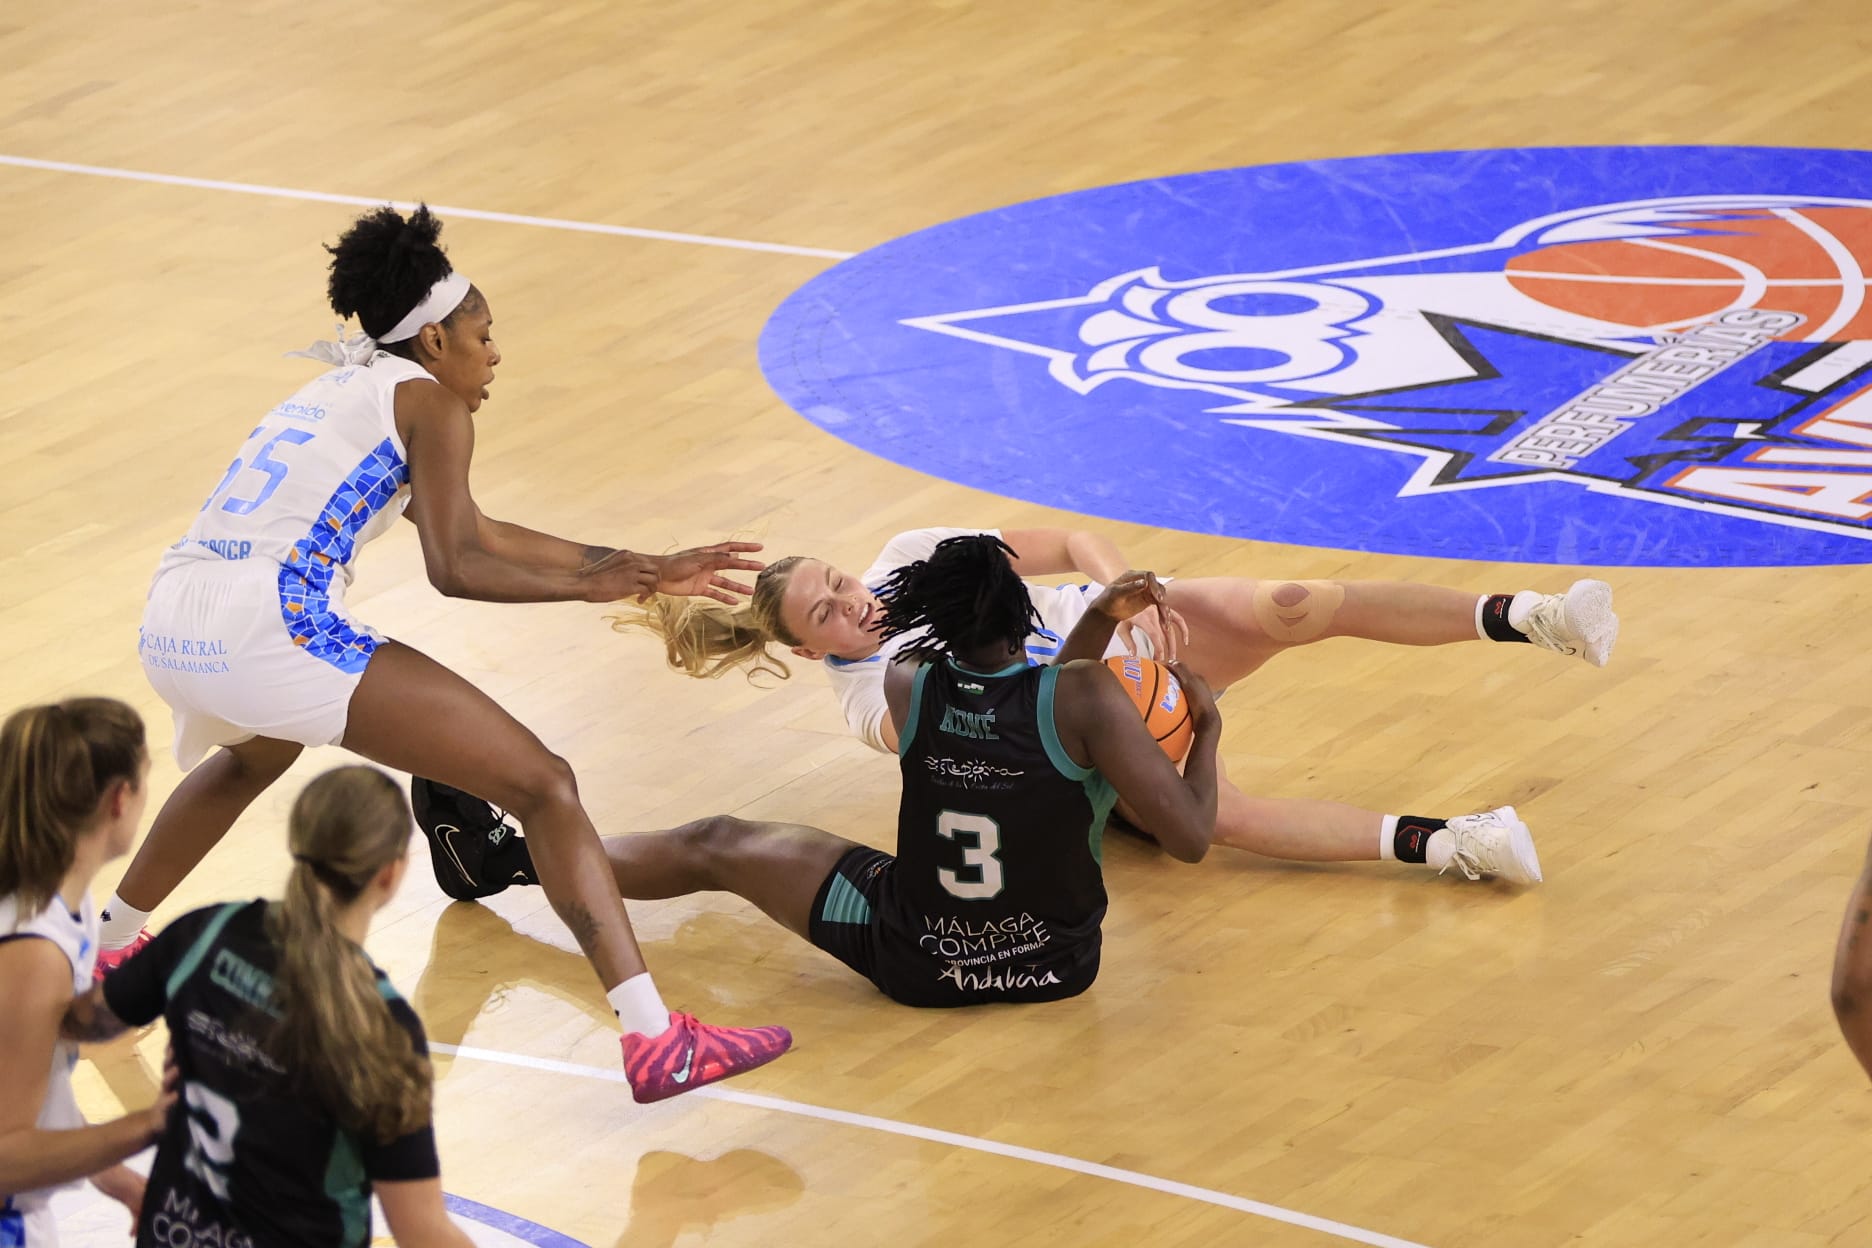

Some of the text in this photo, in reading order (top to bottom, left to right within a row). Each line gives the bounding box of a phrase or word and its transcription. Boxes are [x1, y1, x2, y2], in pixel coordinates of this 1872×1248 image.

[147, 633, 227, 656] CAJA RURAL
[148, 654, 230, 674] DE SALAMANCA
[936, 808, 1005, 901] 3
[924, 912, 1035, 937] MÁLAGA
[919, 920, 1051, 956] COMPITE
[998, 949, 1011, 960] EN
[1012, 940, 1046, 957] FORMA
[184, 1081, 242, 1200] 2
